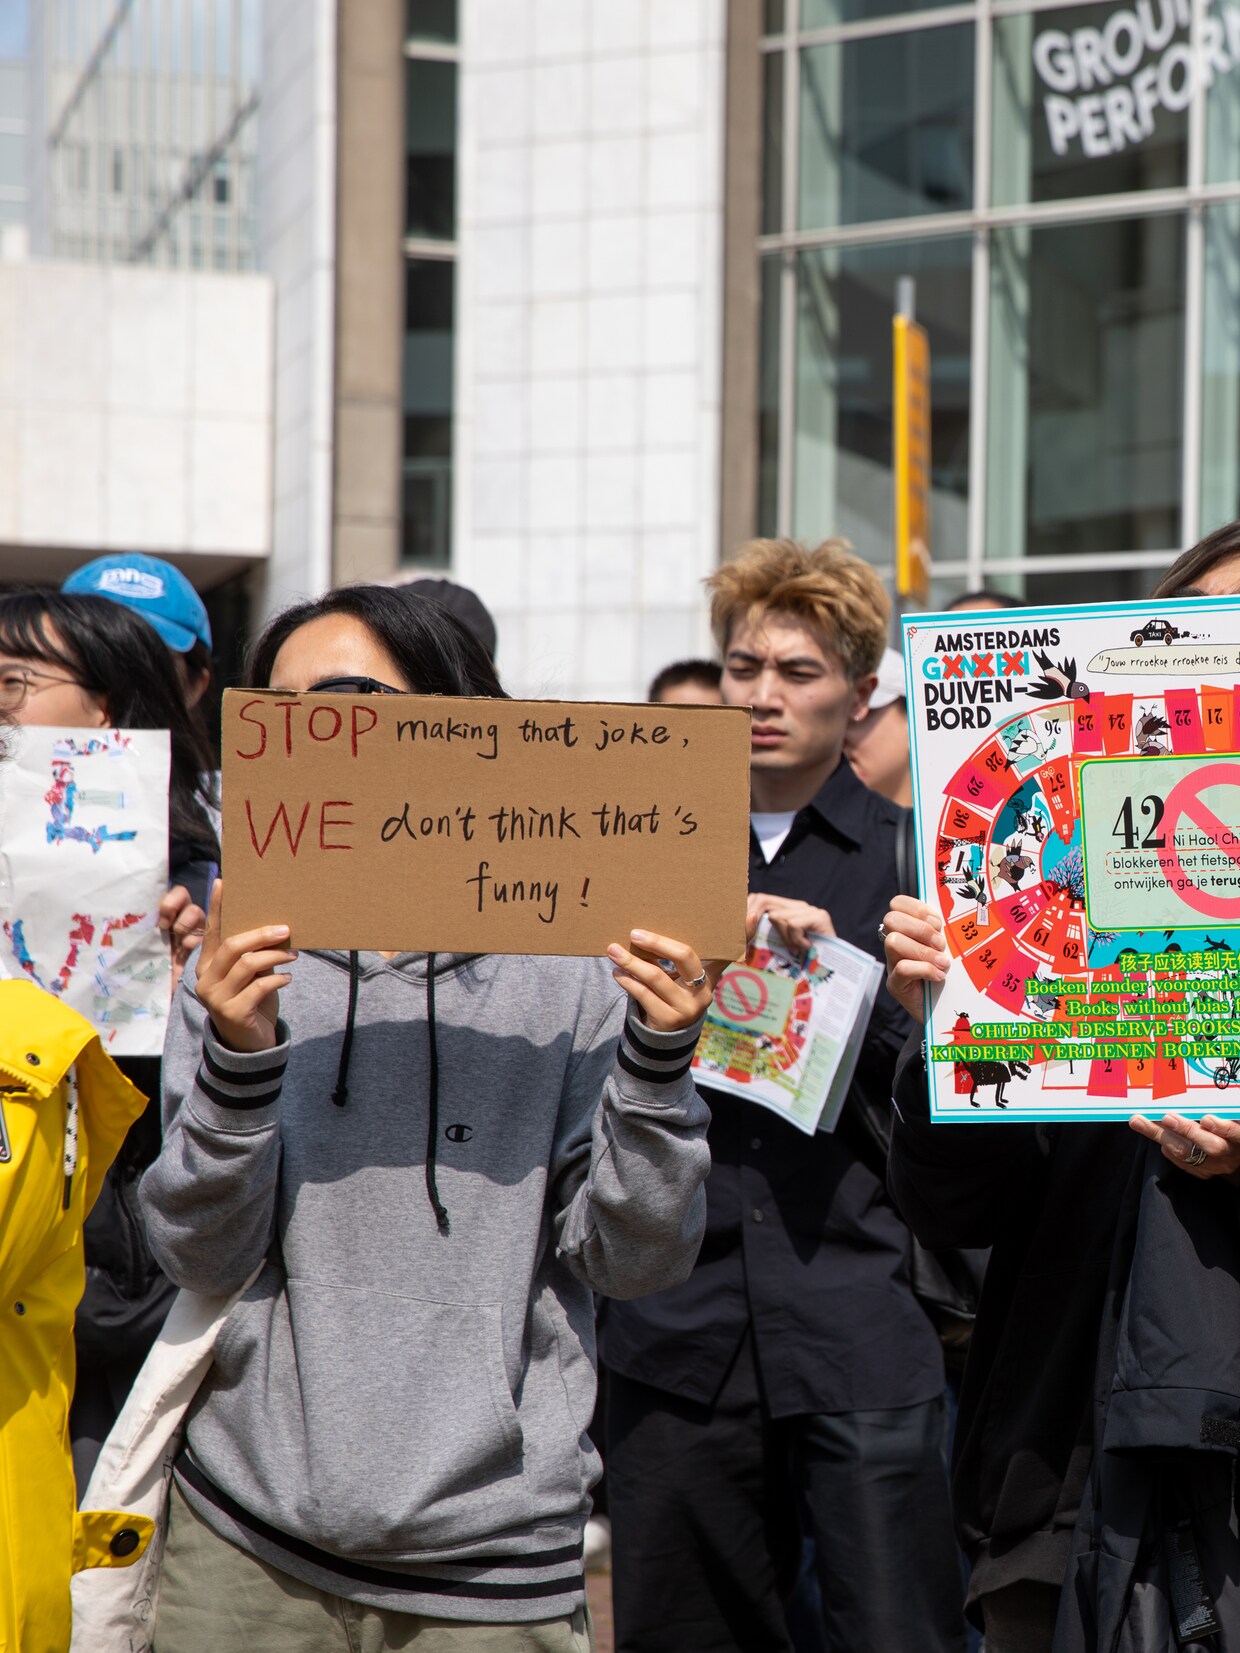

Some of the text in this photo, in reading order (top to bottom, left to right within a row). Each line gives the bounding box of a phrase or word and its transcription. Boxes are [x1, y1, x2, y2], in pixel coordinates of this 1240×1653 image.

[935, 627, 1060, 652] AMSTERDAMS
[1214, 655, 1228, 665] reis
[924, 679, 1028, 706] DUIVEN-
[927, 705, 991, 731] BORD
[1175, 709, 1191, 726] 22
[236, 699, 377, 759] STOP
[397, 717, 498, 759] making
[518, 717, 578, 747] that
[245, 799, 354, 858] WE
[381, 802, 475, 842] don't
[489, 806, 581, 842] think
[1112, 794, 1166, 850] 42
[1173, 834, 1185, 846] Ni
[1189, 834, 1218, 846] Hao!
[1113, 856, 1174, 869] blokkeren
[1178, 855, 1197, 867] het
[466, 861, 558, 923] funny
[1114, 876, 1172, 892] ontwijken
[1177, 879, 1193, 890] ga
[1197, 875, 1208, 890] je
[979, 949, 997, 970] 34
[1063, 942, 1079, 960] 62
[1026, 979, 1087, 995] Boeken
[1092, 979, 1147, 993] zonder
[1068, 1000, 1119, 1015] Books
[1125, 1000, 1189, 1014] without
[1196, 998, 1228, 1013] bias
[971, 1023, 1071, 1038] CHILDREN
[1078, 1022, 1167, 1037] DESERVE
[932, 1046, 1033, 1061] KINDEREN
[1041, 1043, 1156, 1060] VERDIENEN
